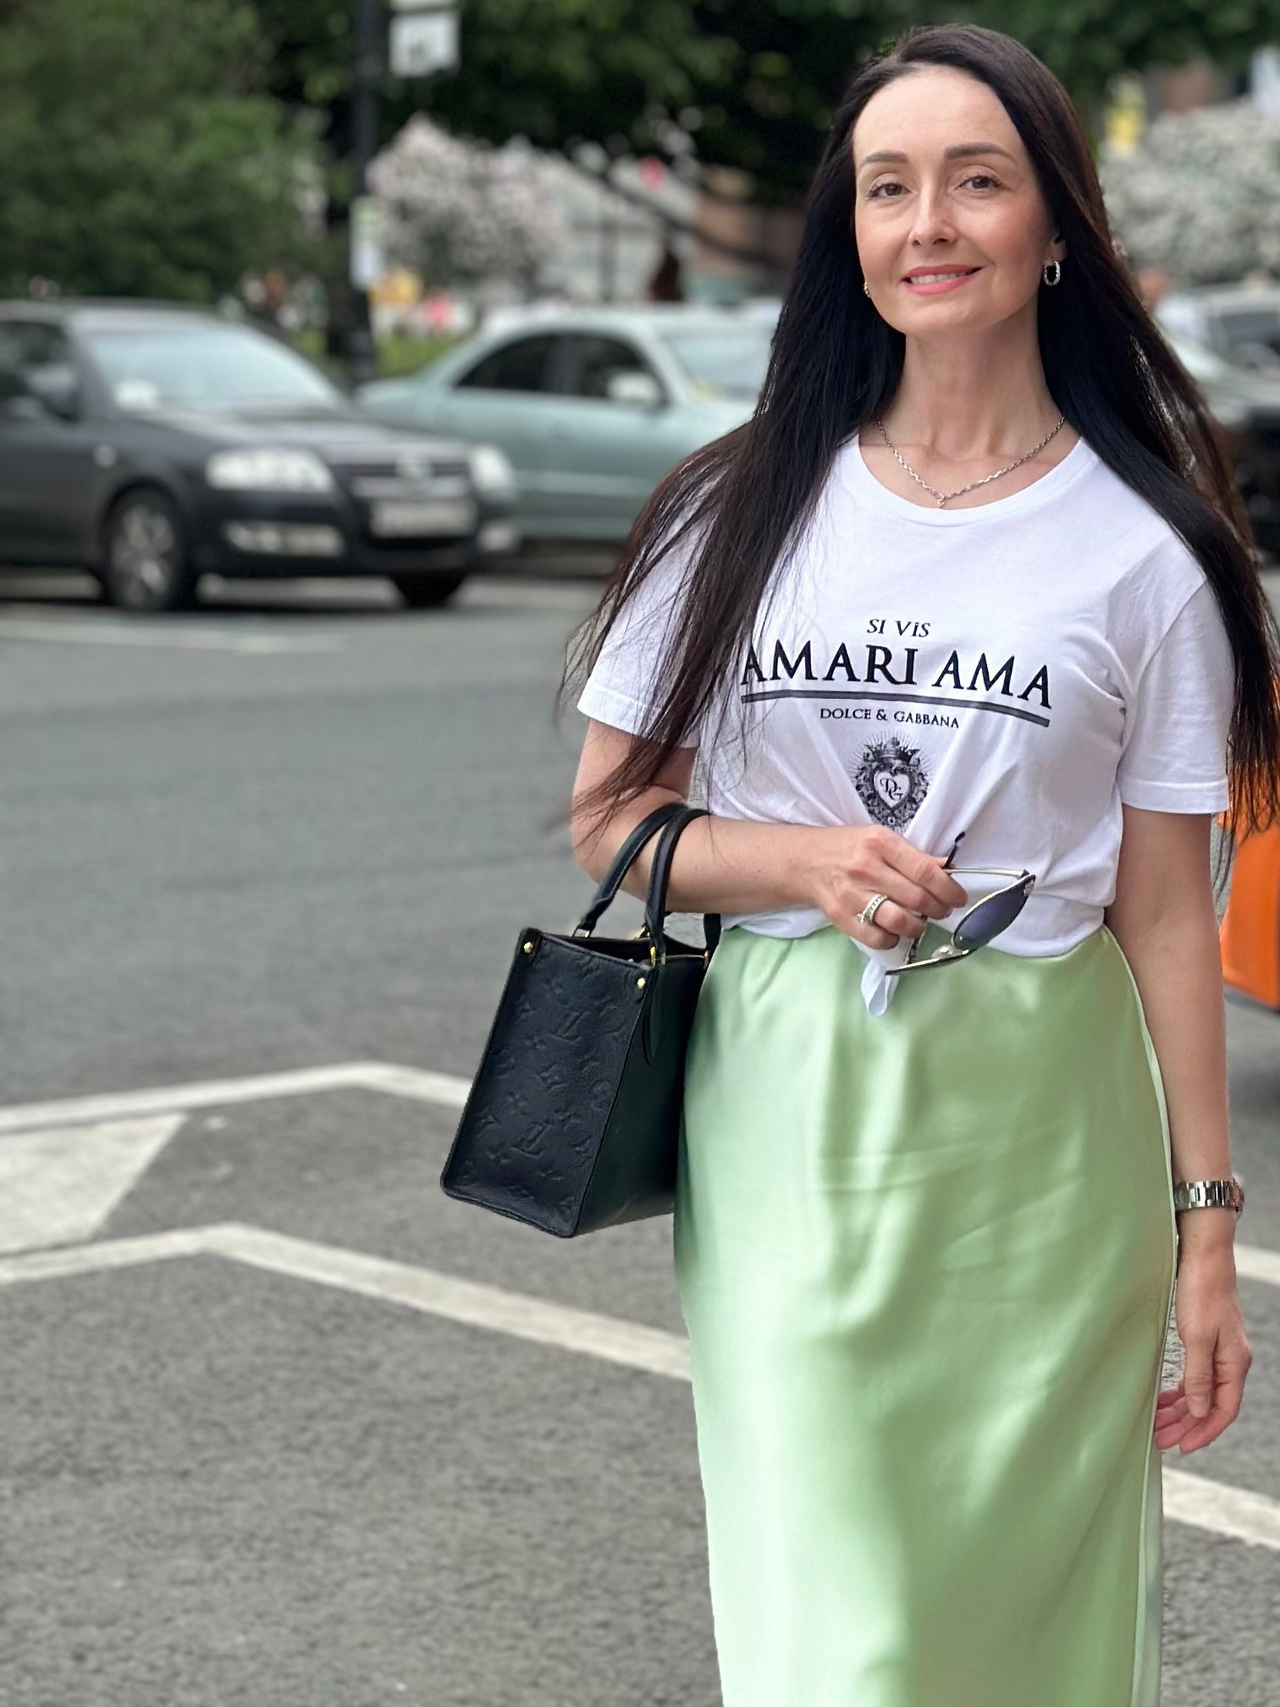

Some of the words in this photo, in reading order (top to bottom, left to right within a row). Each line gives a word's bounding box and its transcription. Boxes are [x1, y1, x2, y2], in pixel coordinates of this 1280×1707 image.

[866, 619, 886, 635] SI
[896, 620, 931, 638] VIS
[740, 639, 918, 685] AMARI
[931, 649, 1052, 709] AMA
[820, 707, 871, 720] DOLCE
[876, 708, 888, 722] &
[893, 710, 959, 728] GABBANA
